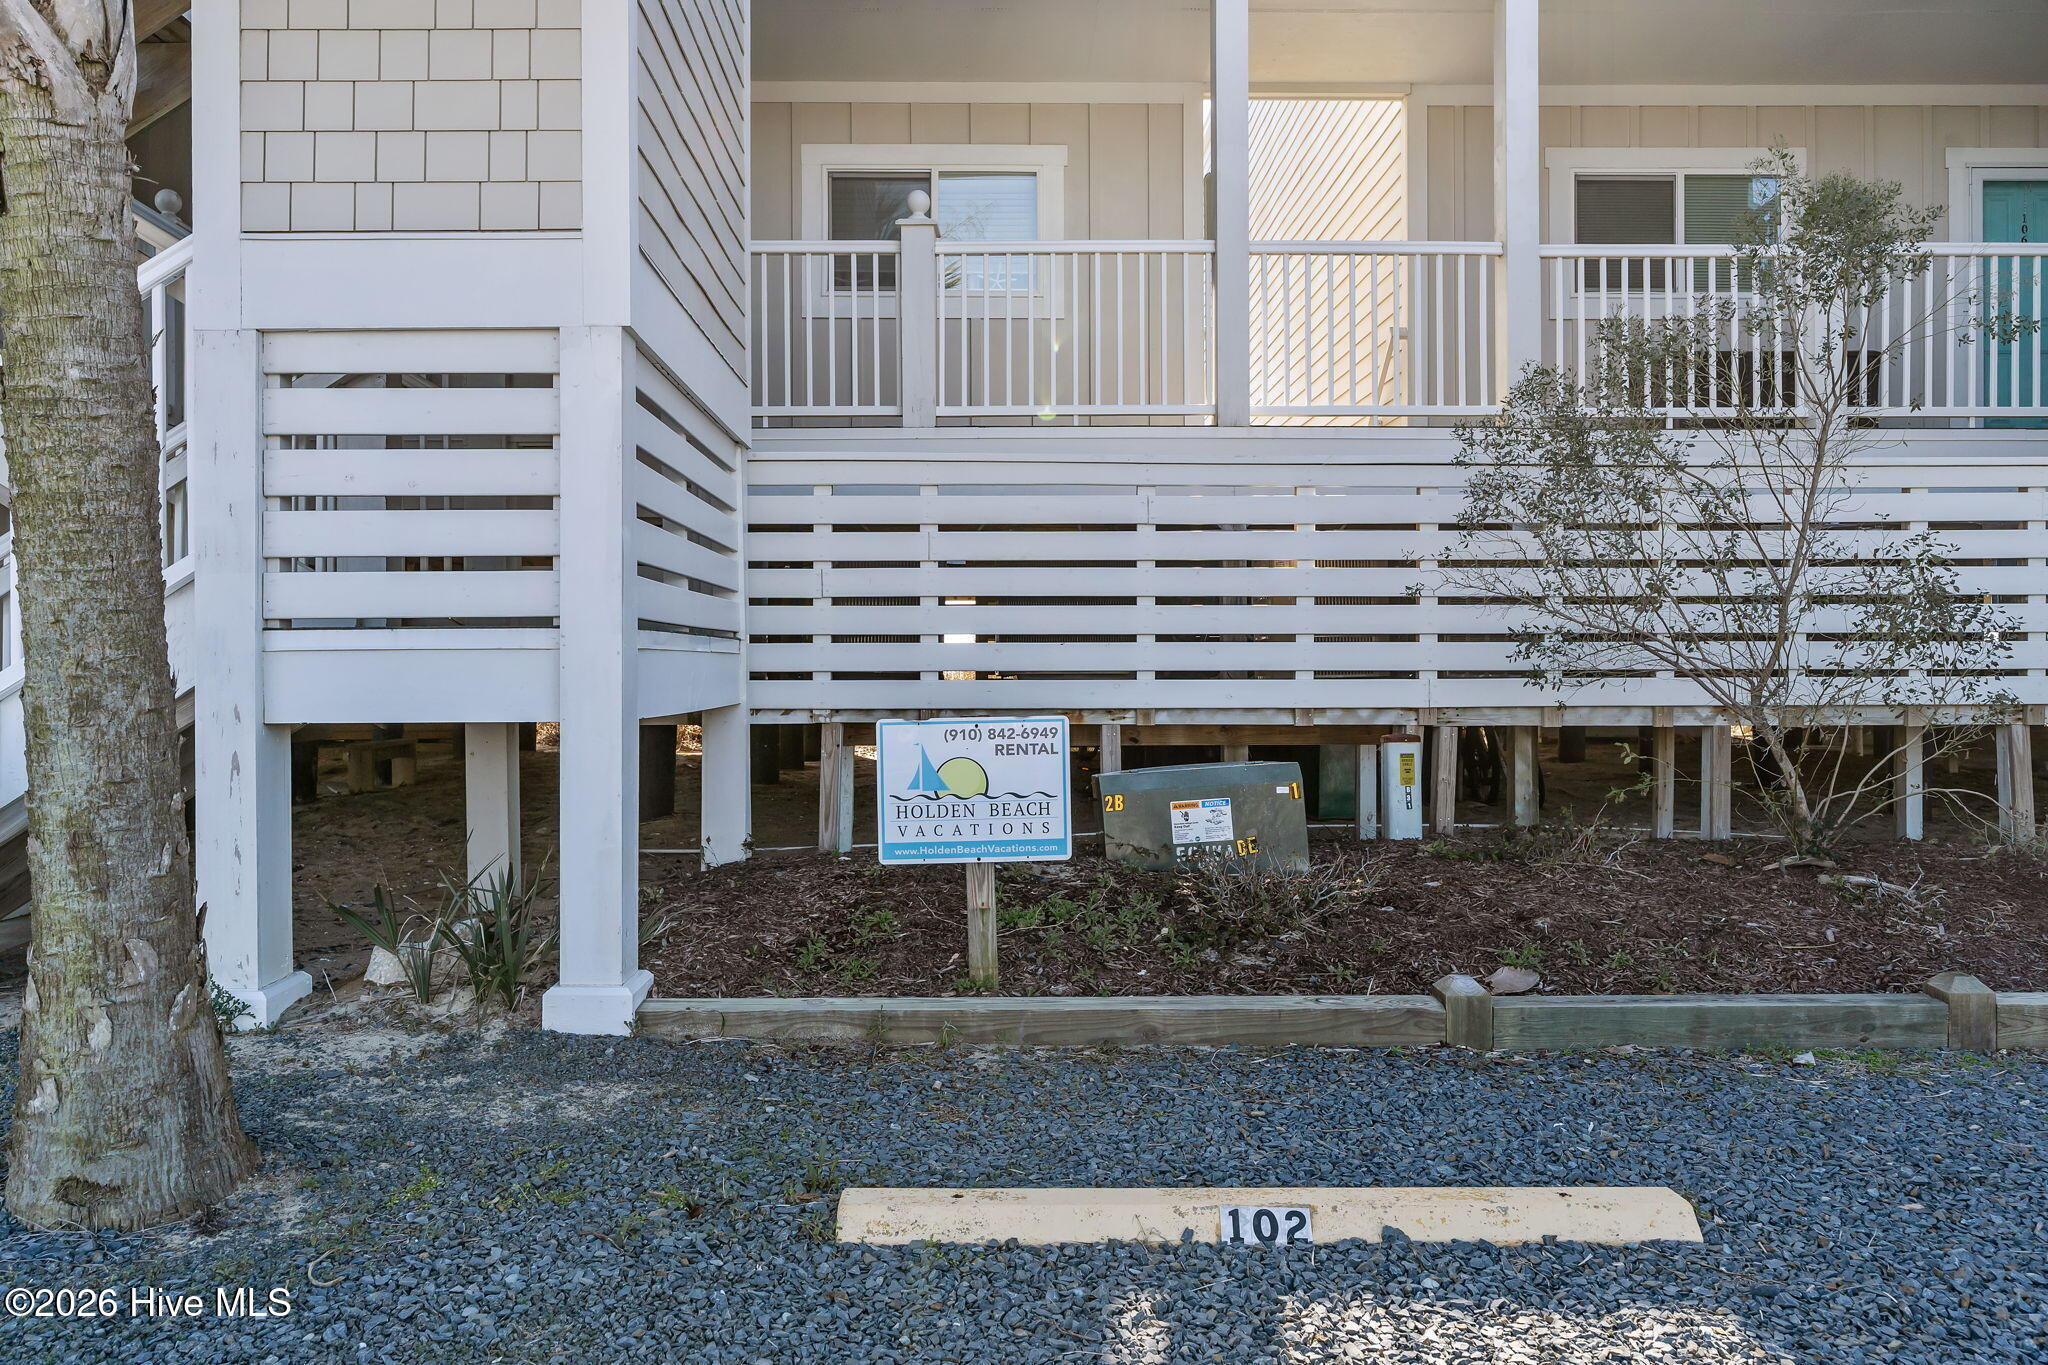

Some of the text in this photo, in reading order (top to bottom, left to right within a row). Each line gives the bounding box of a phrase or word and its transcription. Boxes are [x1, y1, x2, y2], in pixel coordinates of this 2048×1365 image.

[944, 727, 1059, 743] (910) 842-6949
[994, 742, 1059, 756] RENTAL
[896, 801, 1051, 819] HOLDEN BEACH
[1104, 794, 1124, 812] 2B
[898, 821, 1050, 837] VACATIONS
[894, 843, 1058, 856] www.HoldenBeachVacations.com
[1228, 1208, 1309, 1244] 102
